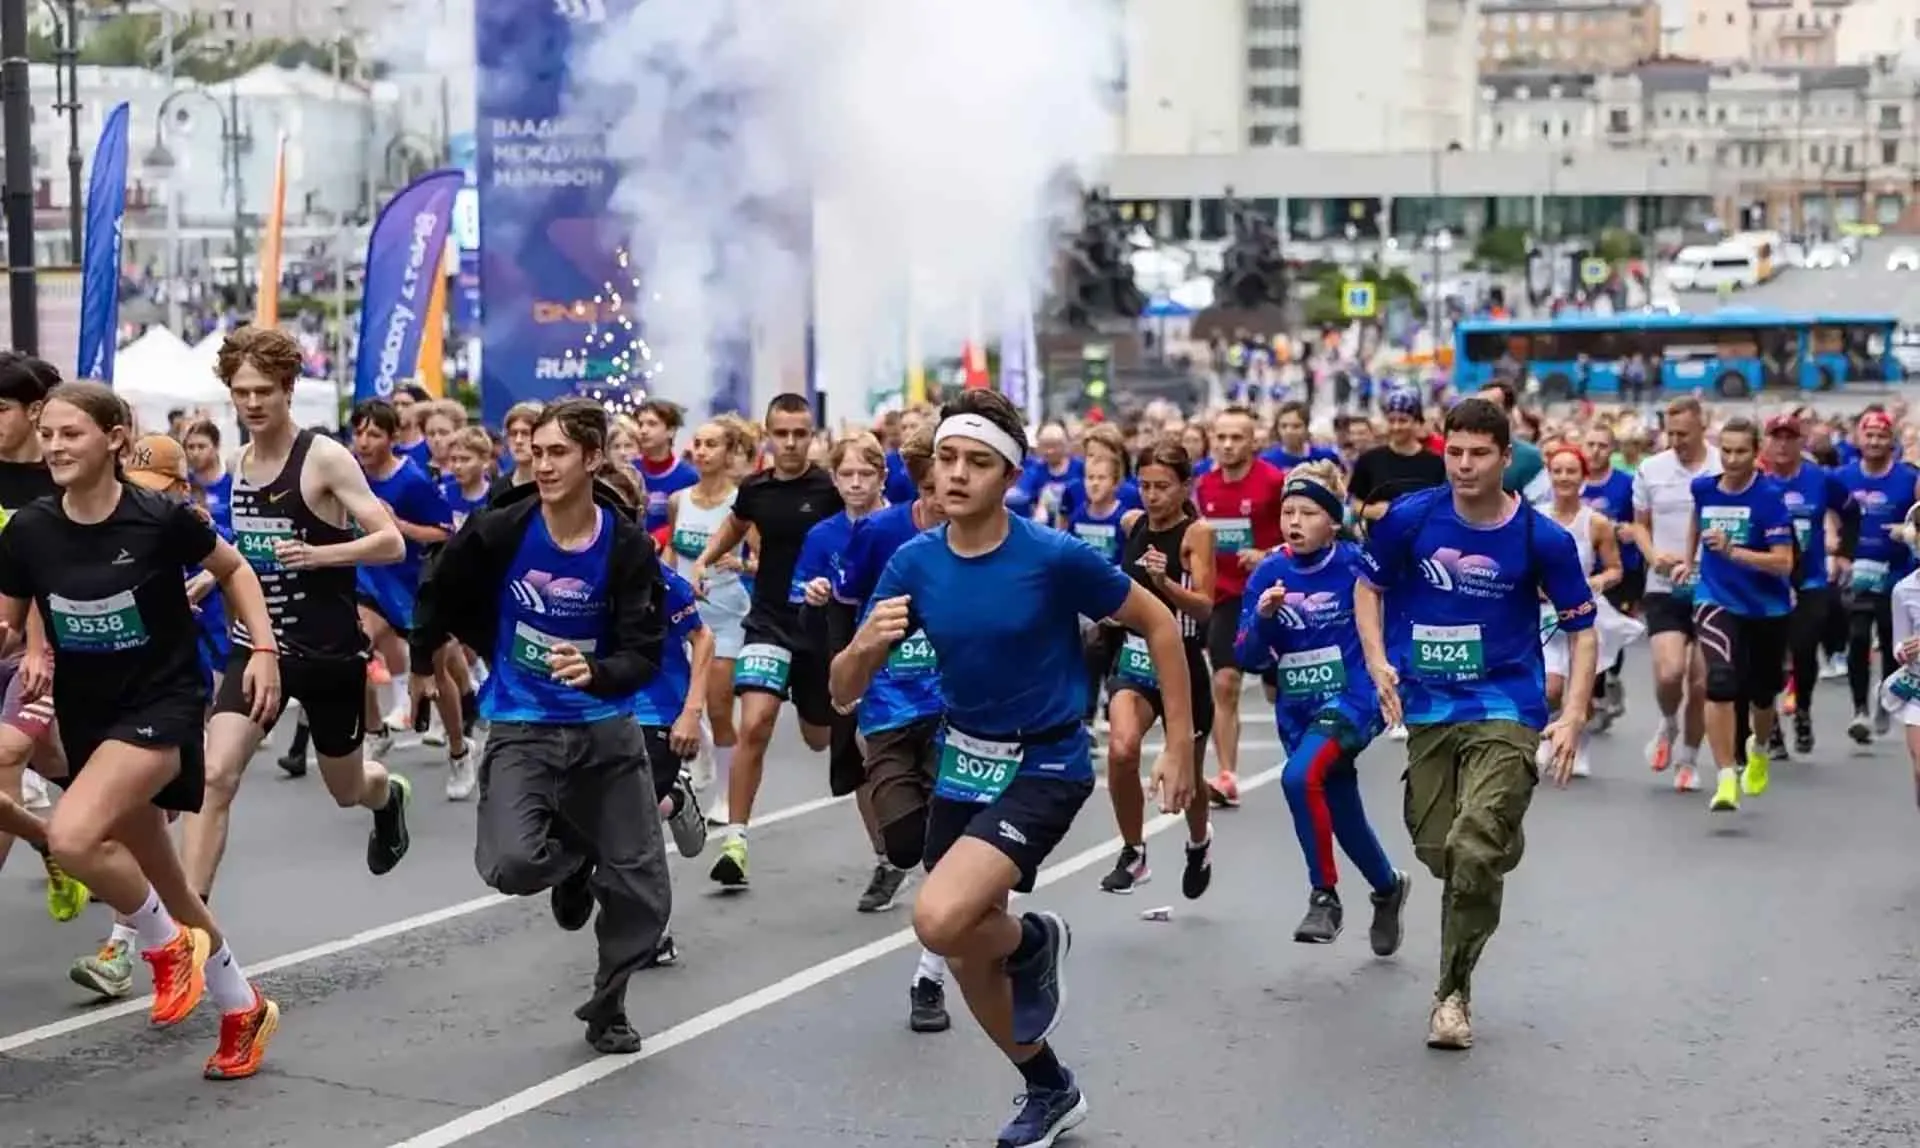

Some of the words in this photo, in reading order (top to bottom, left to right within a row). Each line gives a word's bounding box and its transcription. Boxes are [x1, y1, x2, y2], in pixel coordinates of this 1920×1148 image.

[493, 168, 604, 188] МАРАФОН
[65, 614, 124, 633] 9538
[1421, 643, 1469, 662] 9424
[1286, 665, 1333, 687] 9420
[956, 753, 1008, 783] 9076
